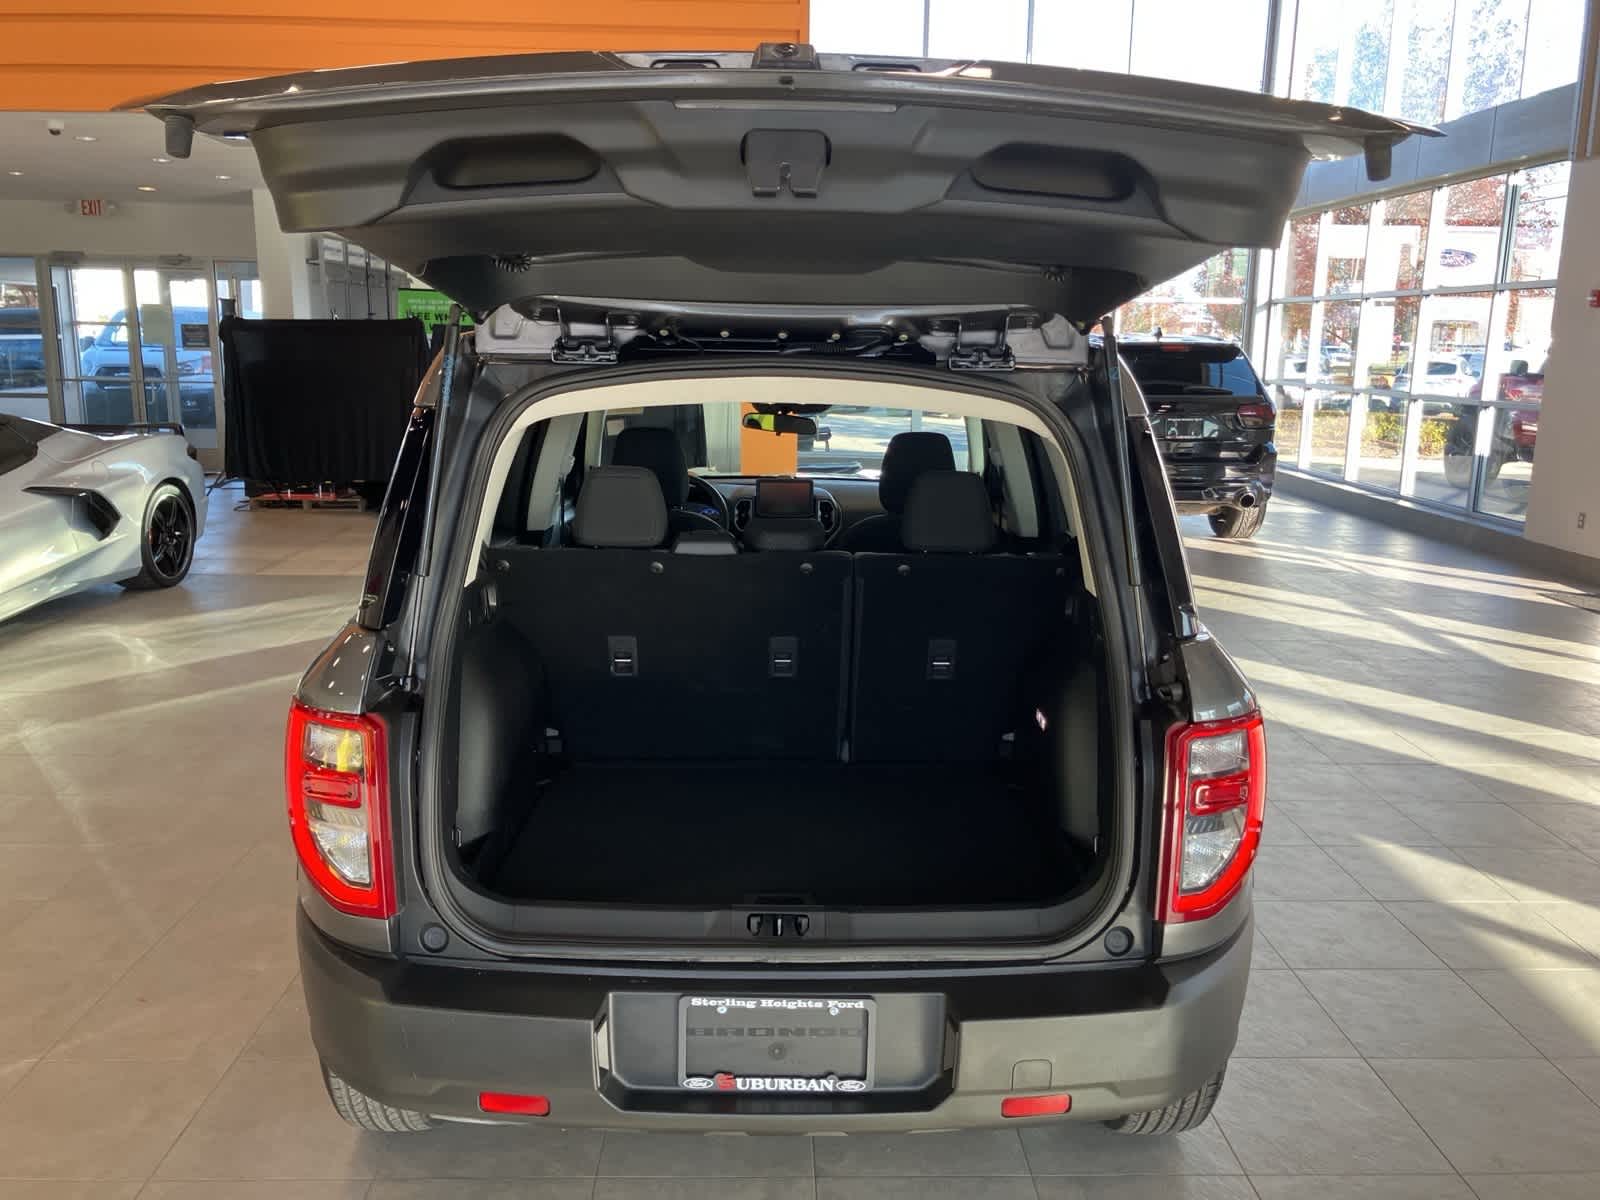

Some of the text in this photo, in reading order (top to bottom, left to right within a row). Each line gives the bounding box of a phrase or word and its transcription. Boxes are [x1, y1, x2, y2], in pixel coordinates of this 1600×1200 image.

[80, 199, 102, 217] EXIT
[691, 997, 864, 1009] Sterling Heights Ford
[715, 1073, 834, 1091] SUBURBAN
